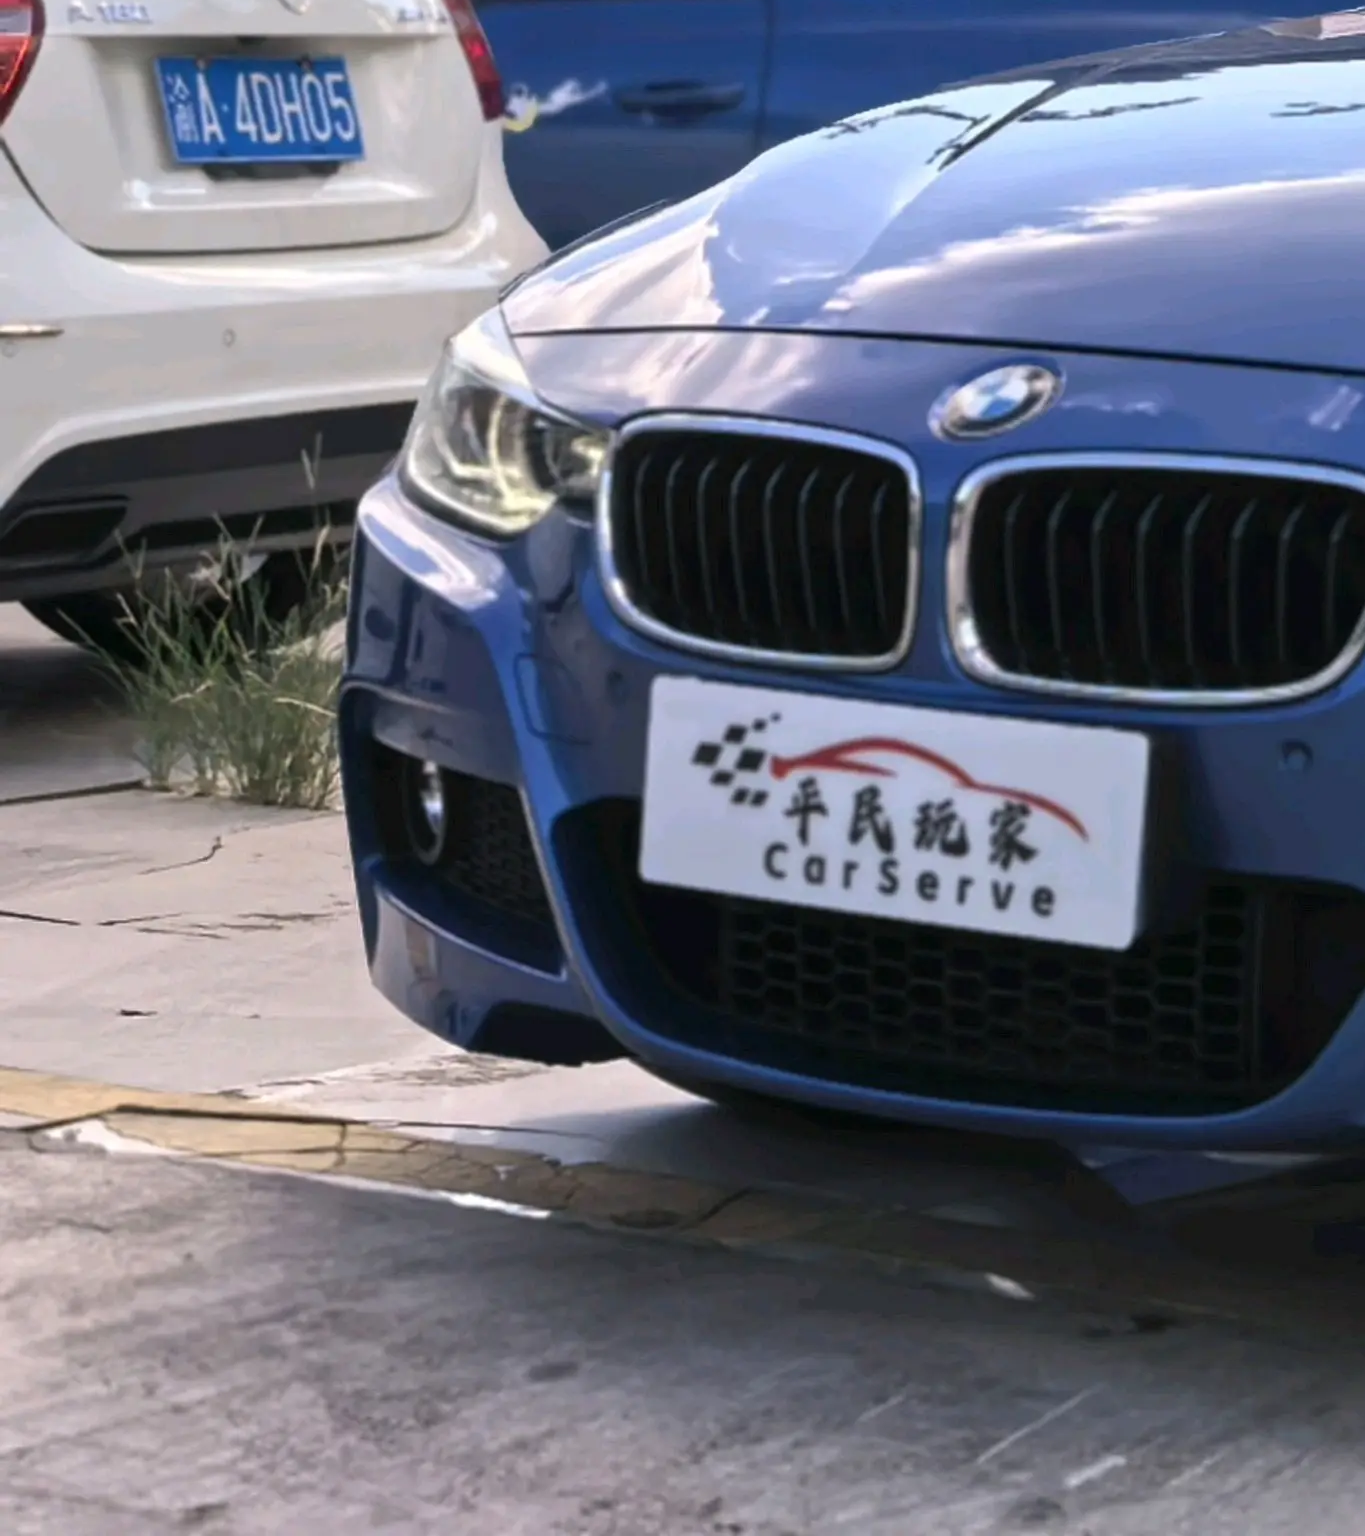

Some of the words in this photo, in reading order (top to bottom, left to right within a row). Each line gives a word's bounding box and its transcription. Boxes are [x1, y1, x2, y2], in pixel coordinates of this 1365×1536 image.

[784, 777, 1039, 870] 平民玩家
[763, 842, 1056, 917] CarServe
